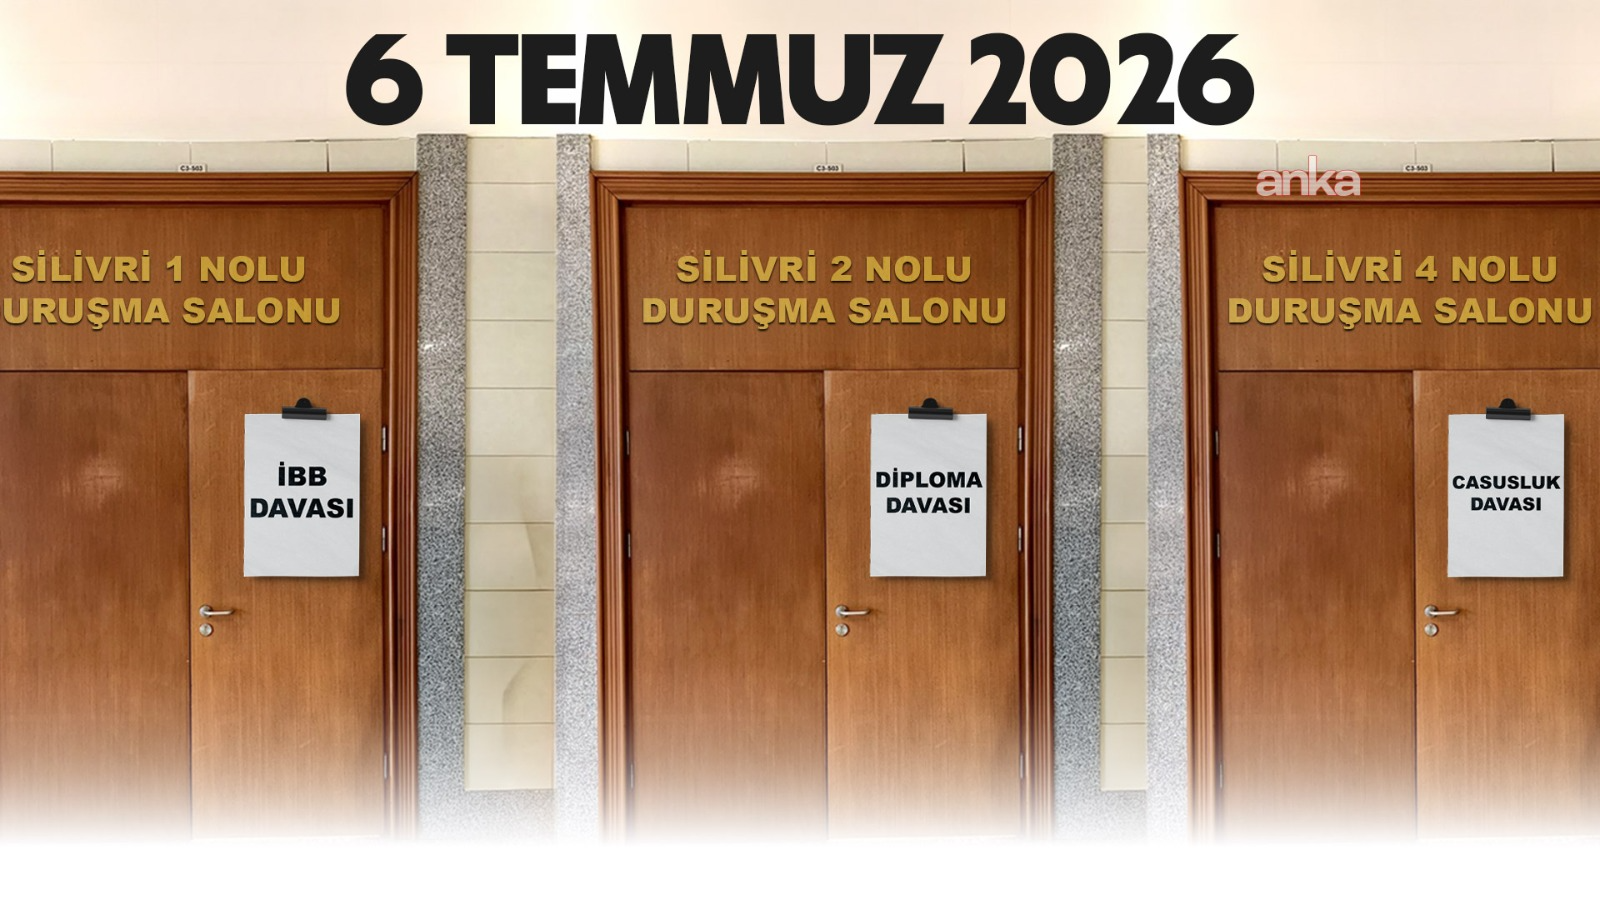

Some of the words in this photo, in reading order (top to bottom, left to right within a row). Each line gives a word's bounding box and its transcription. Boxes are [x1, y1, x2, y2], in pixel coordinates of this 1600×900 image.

[12, 249, 151, 283] SİLİVRİ
[166, 255, 183, 283] 1
[200, 256, 306, 283] NOLU
[676, 249, 817, 283] SİLİVRİ
[831, 255, 853, 283] 2
[866, 256, 972, 283] NOLU
[1262, 249, 1403, 283] SİLİVRİ
[1415, 255, 1438, 283] 4
[1452, 256, 1558, 283] NOLU
[0, 297, 170, 330] URUŞMA
[182, 297, 341, 325] SALONU
[643, 297, 837, 330] DURUŞMA
[848, 297, 1007, 325] SALONU
[1228, 297, 1423, 330] DURUŞMA
[1434, 297, 1593, 325] SALONU
[278, 461, 328, 487] İBB
[875, 467, 983, 489] DİPLOMA
[1452, 475, 1561, 490] CASUSLUK
[250, 497, 354, 519] DAVASI
[886, 497, 971, 514] DAVASI
[1470, 497, 1542, 512] DAVASI
